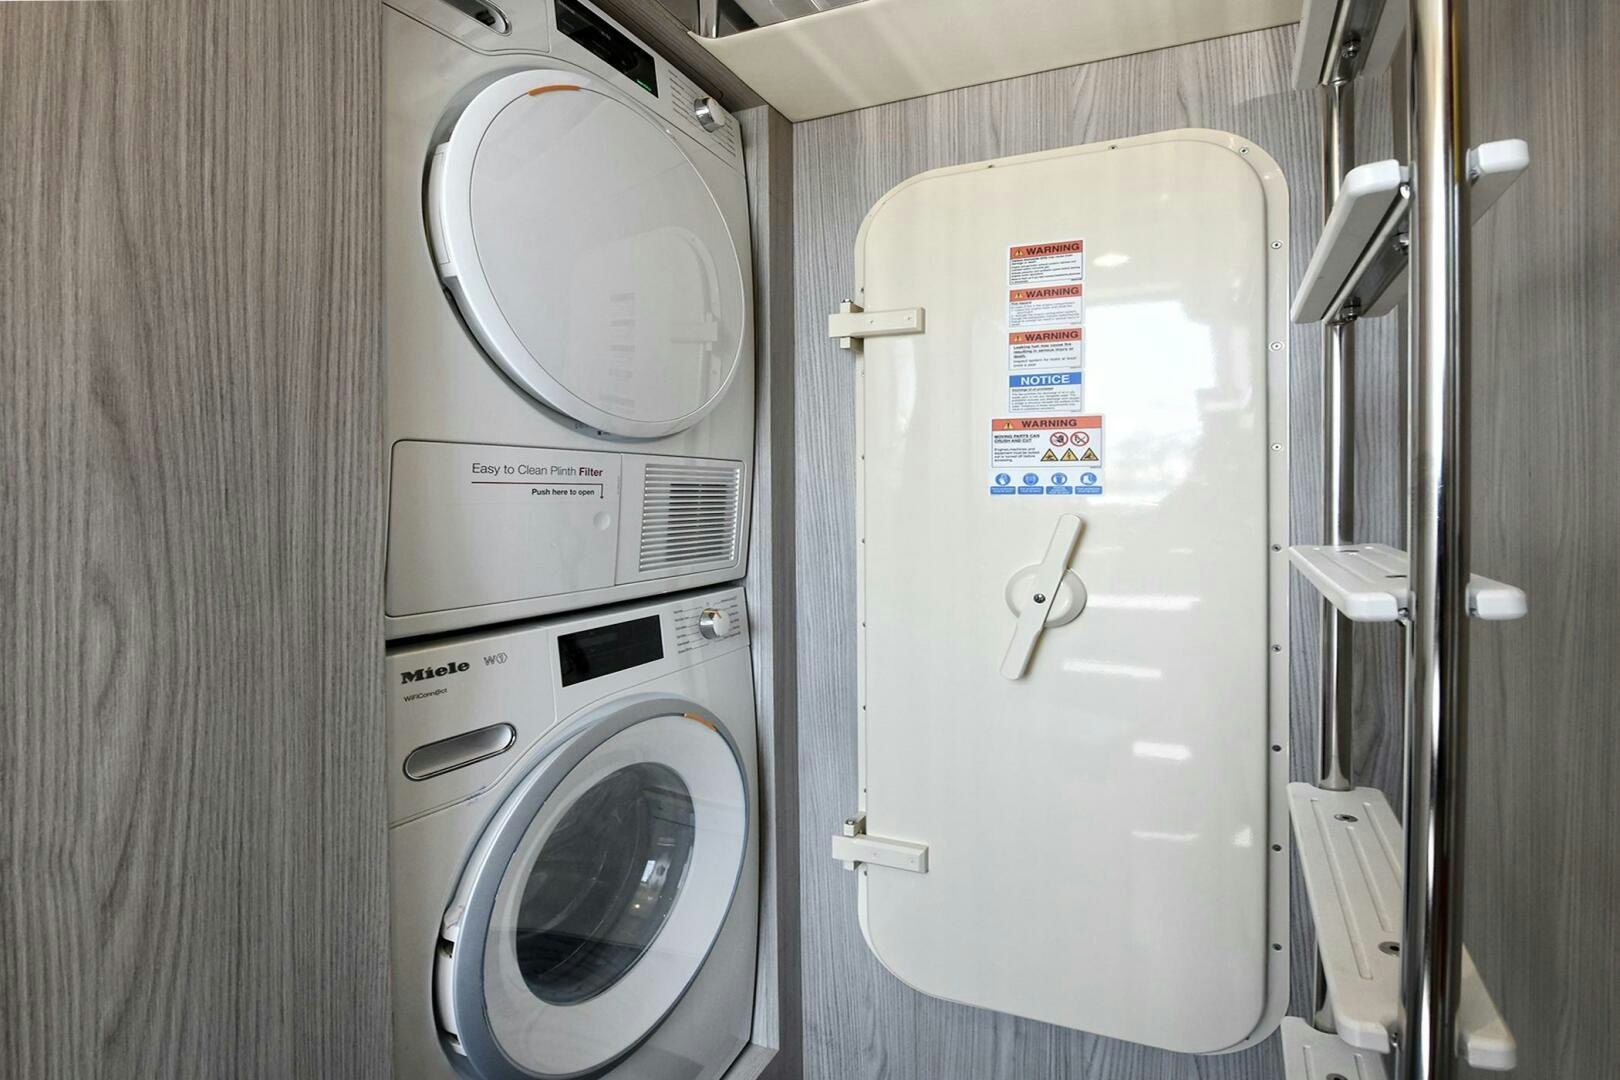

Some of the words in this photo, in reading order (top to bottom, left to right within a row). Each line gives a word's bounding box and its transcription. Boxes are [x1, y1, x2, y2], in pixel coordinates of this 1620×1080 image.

[1026, 242, 1080, 255] WARNING
[1026, 287, 1080, 298] WARNING
[1025, 330, 1079, 342] WARNING
[1020, 374, 1071, 385] NOTICE
[1021, 419, 1078, 428] WARNING
[471, 462, 500, 476] Easy
[503, 465, 515, 475] to
[517, 464, 548, 475] Clean
[550, 465, 577, 476] Plinth
[578, 467, 603, 477] Filter
[531, 488, 551, 496] Push
[552, 488, 568, 496] here
[578, 489, 595, 497] open
[400, 661, 470, 685] Miele
